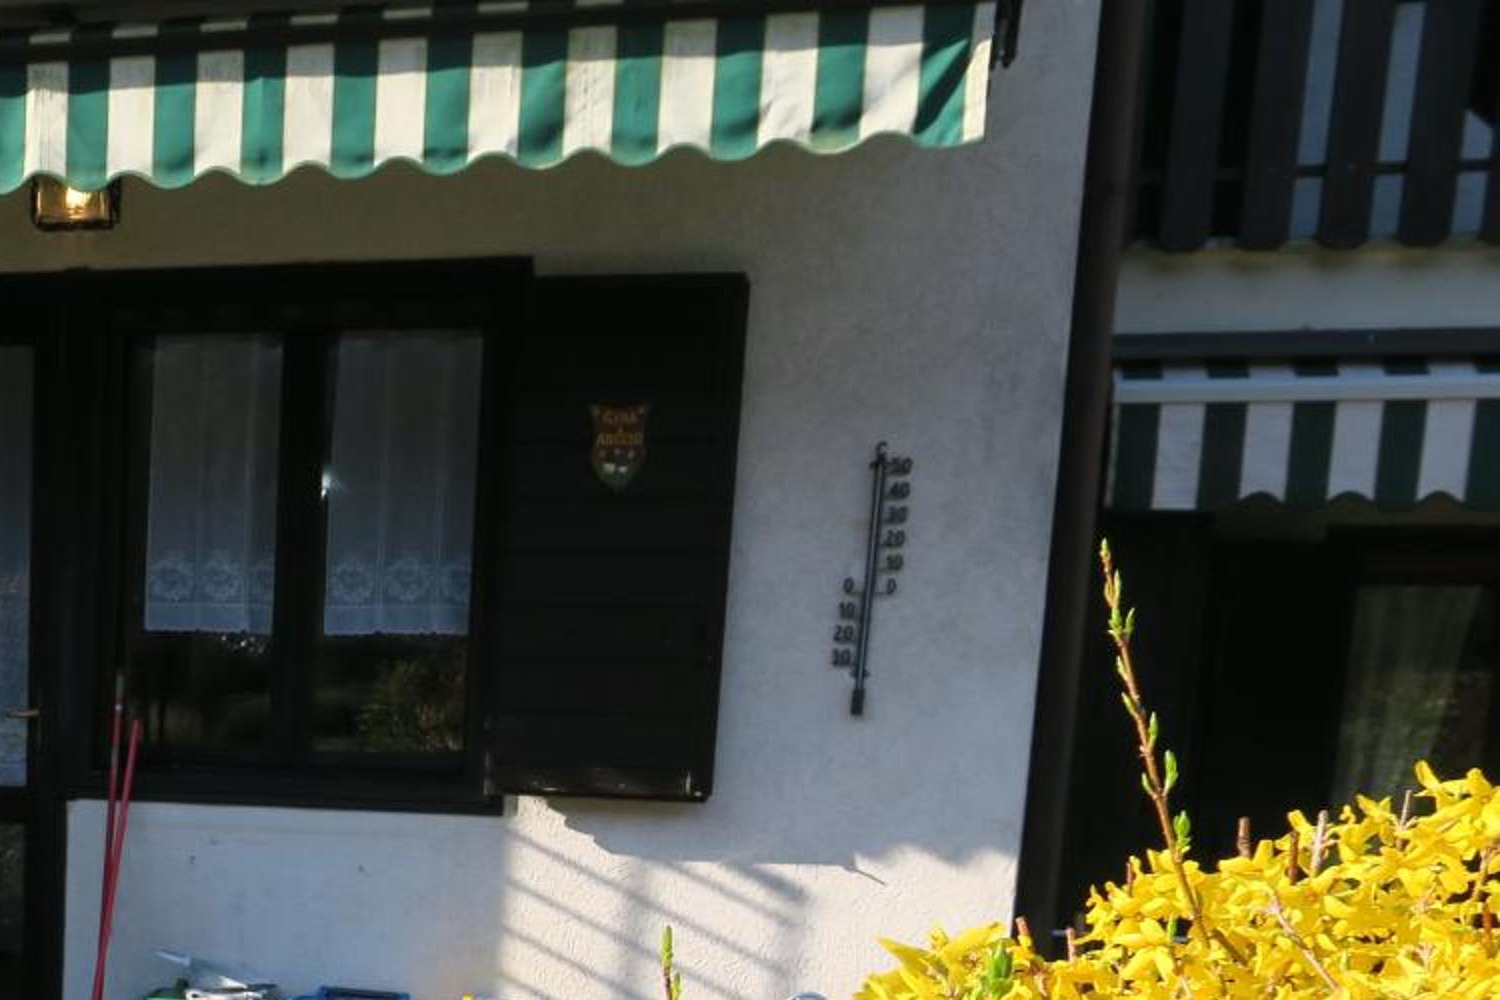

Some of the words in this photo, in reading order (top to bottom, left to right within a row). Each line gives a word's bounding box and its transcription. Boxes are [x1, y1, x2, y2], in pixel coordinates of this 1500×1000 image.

[889, 481, 910, 499] 40
[884, 529, 906, 547] 20
[885, 554, 904, 571] 10
[842, 577, 855, 594] 0
[886, 577, 898, 595] 0
[838, 601, 856, 620] 10
[833, 625, 854, 643] 20
